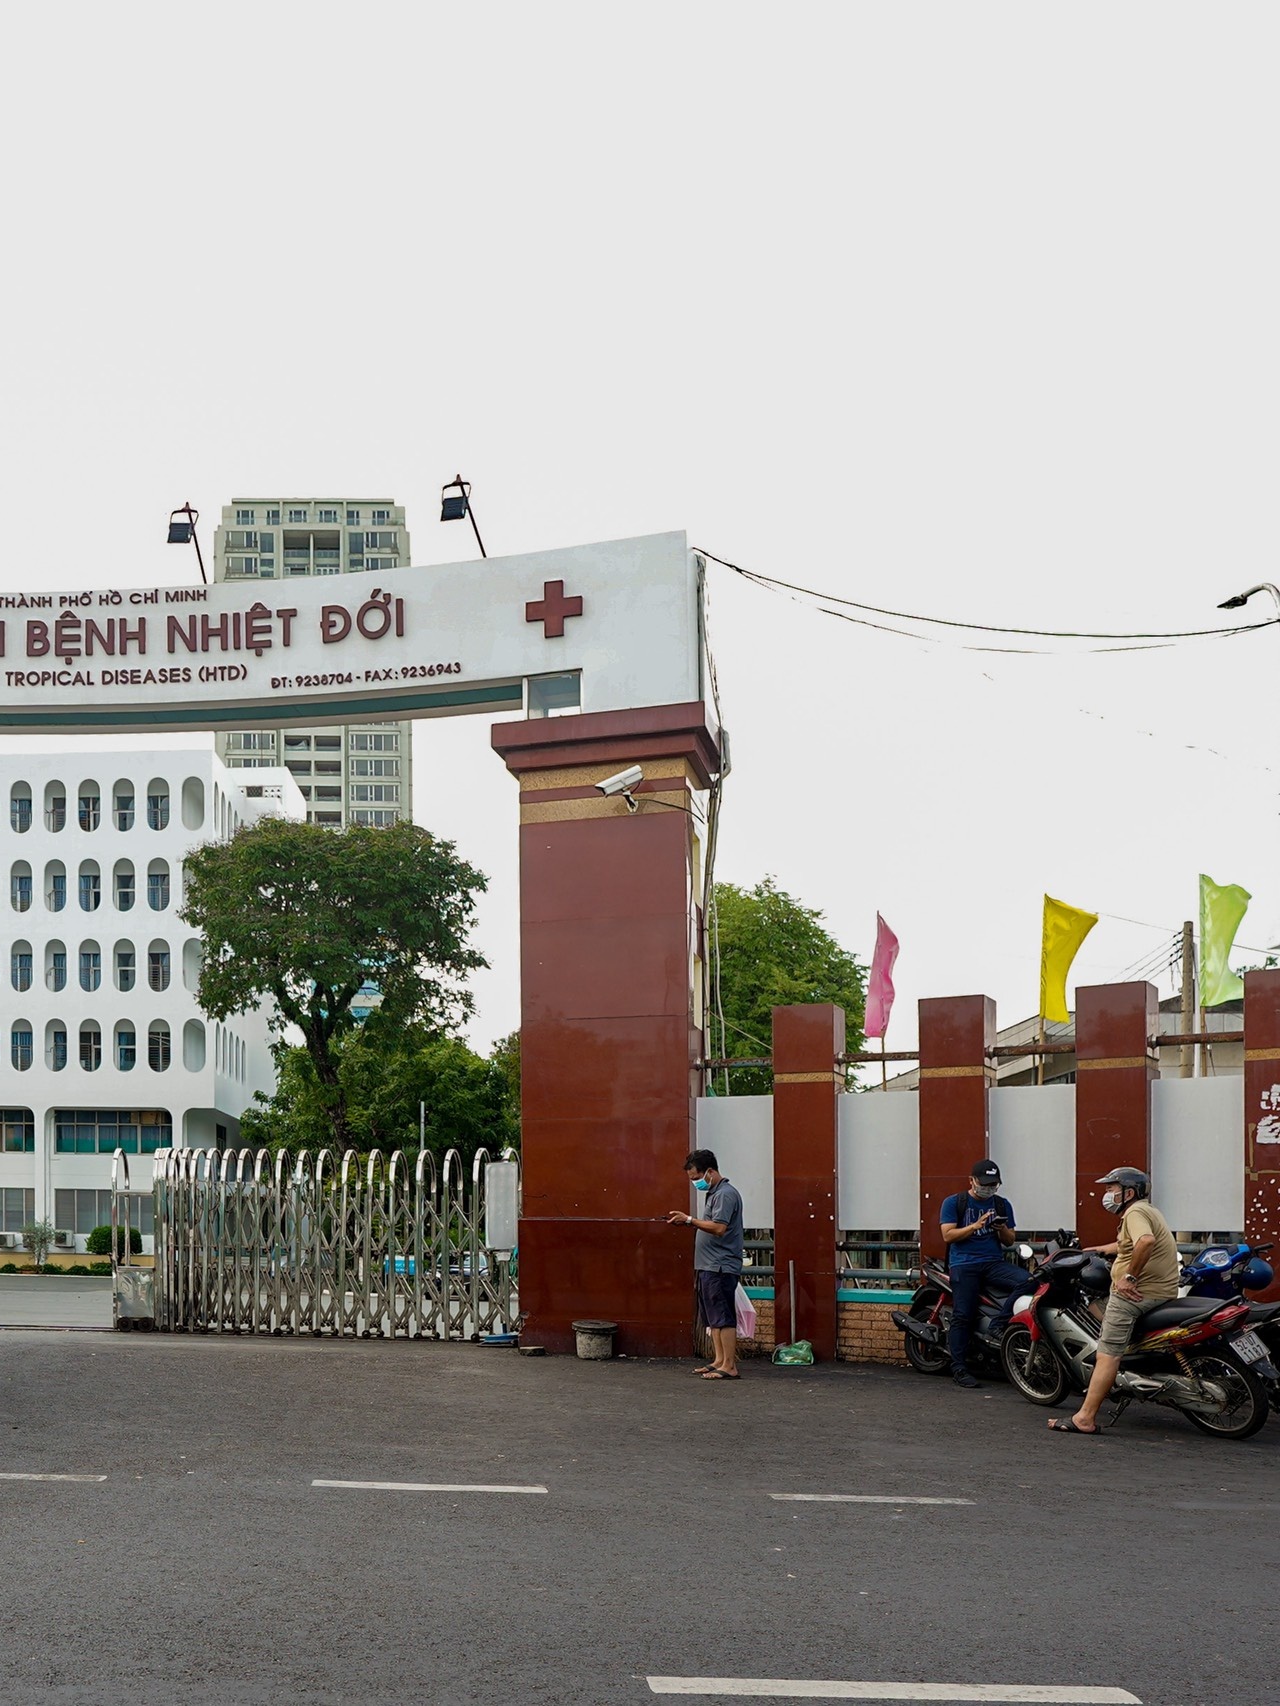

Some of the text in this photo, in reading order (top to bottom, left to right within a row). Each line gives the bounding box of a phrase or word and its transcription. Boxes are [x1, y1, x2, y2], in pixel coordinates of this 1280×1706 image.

[59, 591, 92, 608] PHỐ
[99, 590, 123, 606] HỒ
[129, 589, 159, 605] CHÍ
[165, 589, 207, 604] MINH
[27, 610, 146, 666] BỆNH
[167, 602, 297, 657] NHIỆT
[320, 588, 404, 644] ĐỚI
[5, 670, 95, 687] TROPICAL
[101, 667, 192, 686] DISEASES
[198, 664, 248, 684] (HTD)
[295, 672, 353, 688] 9238704
[400, 661, 462, 679] 9236943
